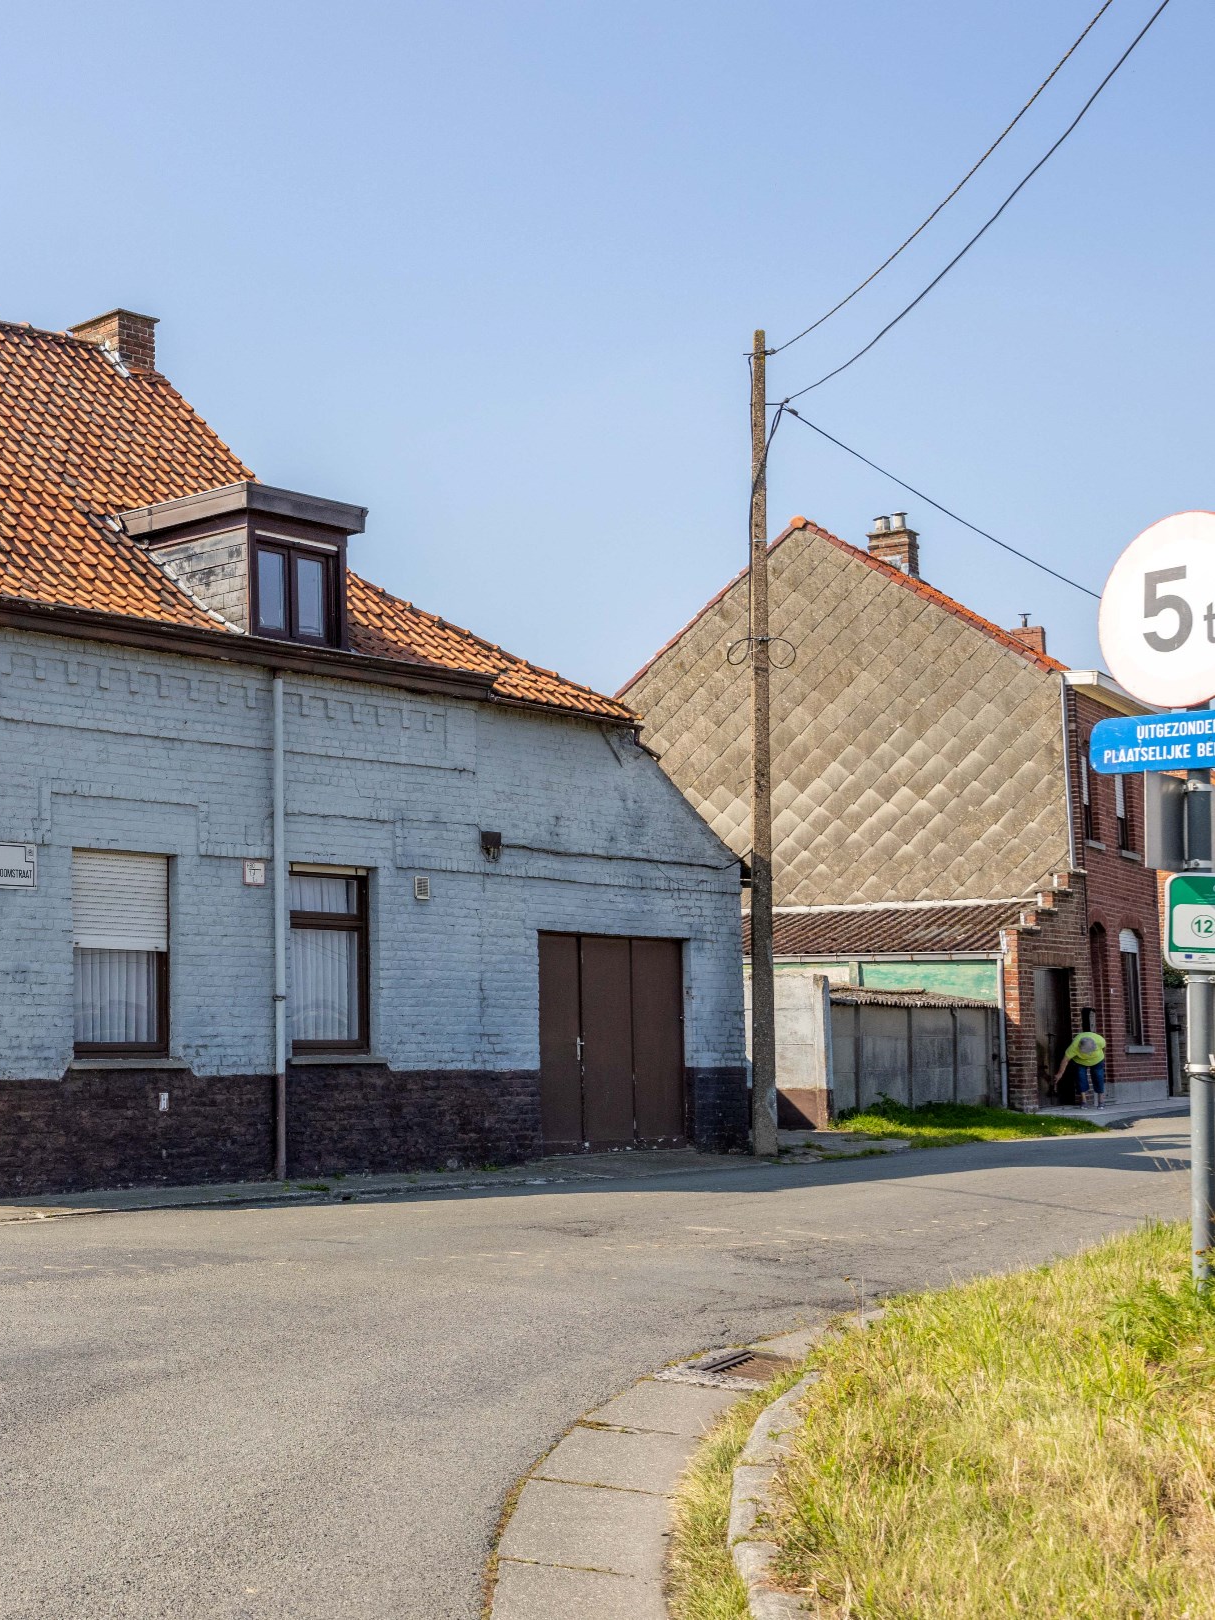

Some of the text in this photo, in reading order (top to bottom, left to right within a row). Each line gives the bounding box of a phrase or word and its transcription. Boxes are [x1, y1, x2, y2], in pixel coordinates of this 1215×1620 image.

[1136, 718, 1215, 740] UITGEZONDE
[1103, 741, 1215, 764] PLAATSELIJKE BE
[1194, 919, 1214, 934] 12
